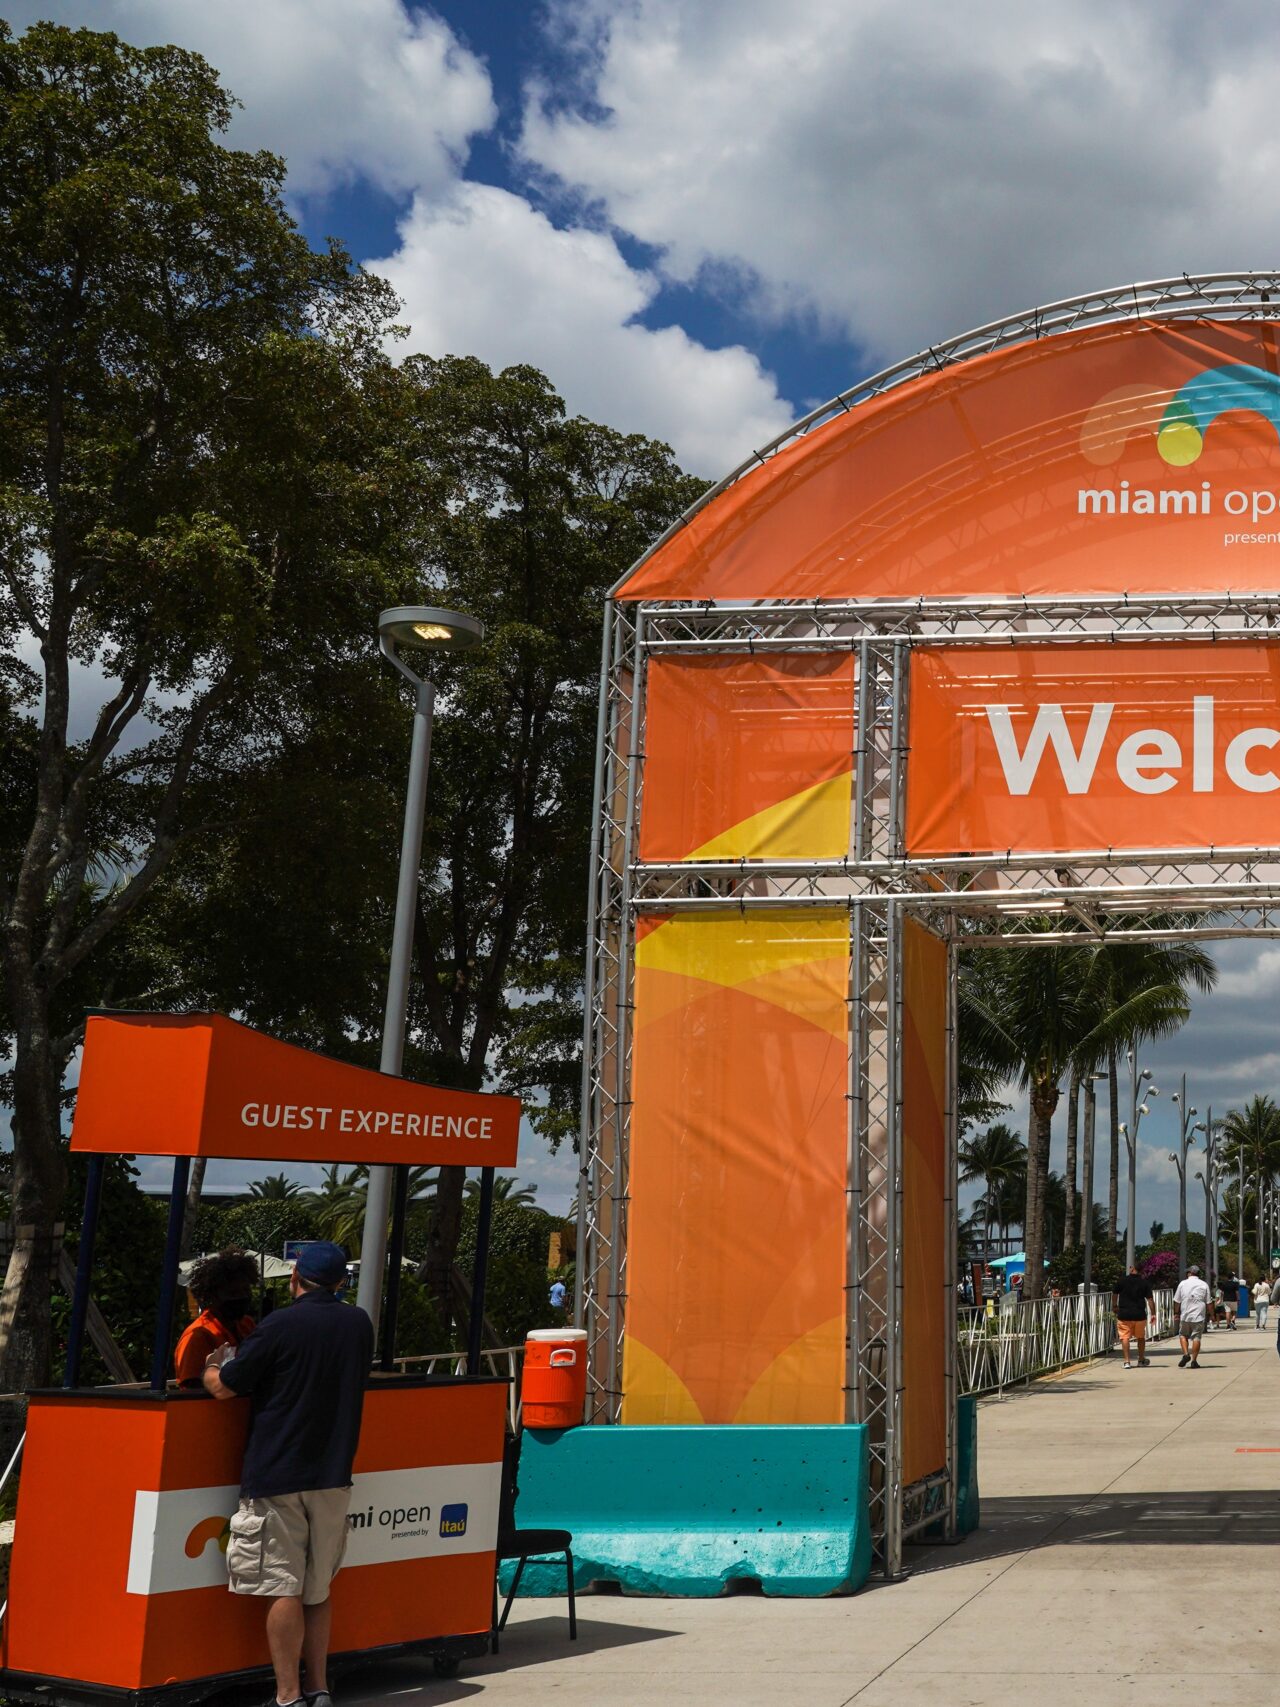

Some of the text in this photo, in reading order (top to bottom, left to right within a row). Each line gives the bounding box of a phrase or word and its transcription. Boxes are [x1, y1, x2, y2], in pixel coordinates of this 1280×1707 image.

[1078, 481, 1211, 515] miami
[241, 1103, 493, 1139] GUEST EXPERIENCE
[379, 1506, 430, 1530] open
[441, 1520, 465, 1534] Itaú
[391, 1529, 429, 1540] presented by
